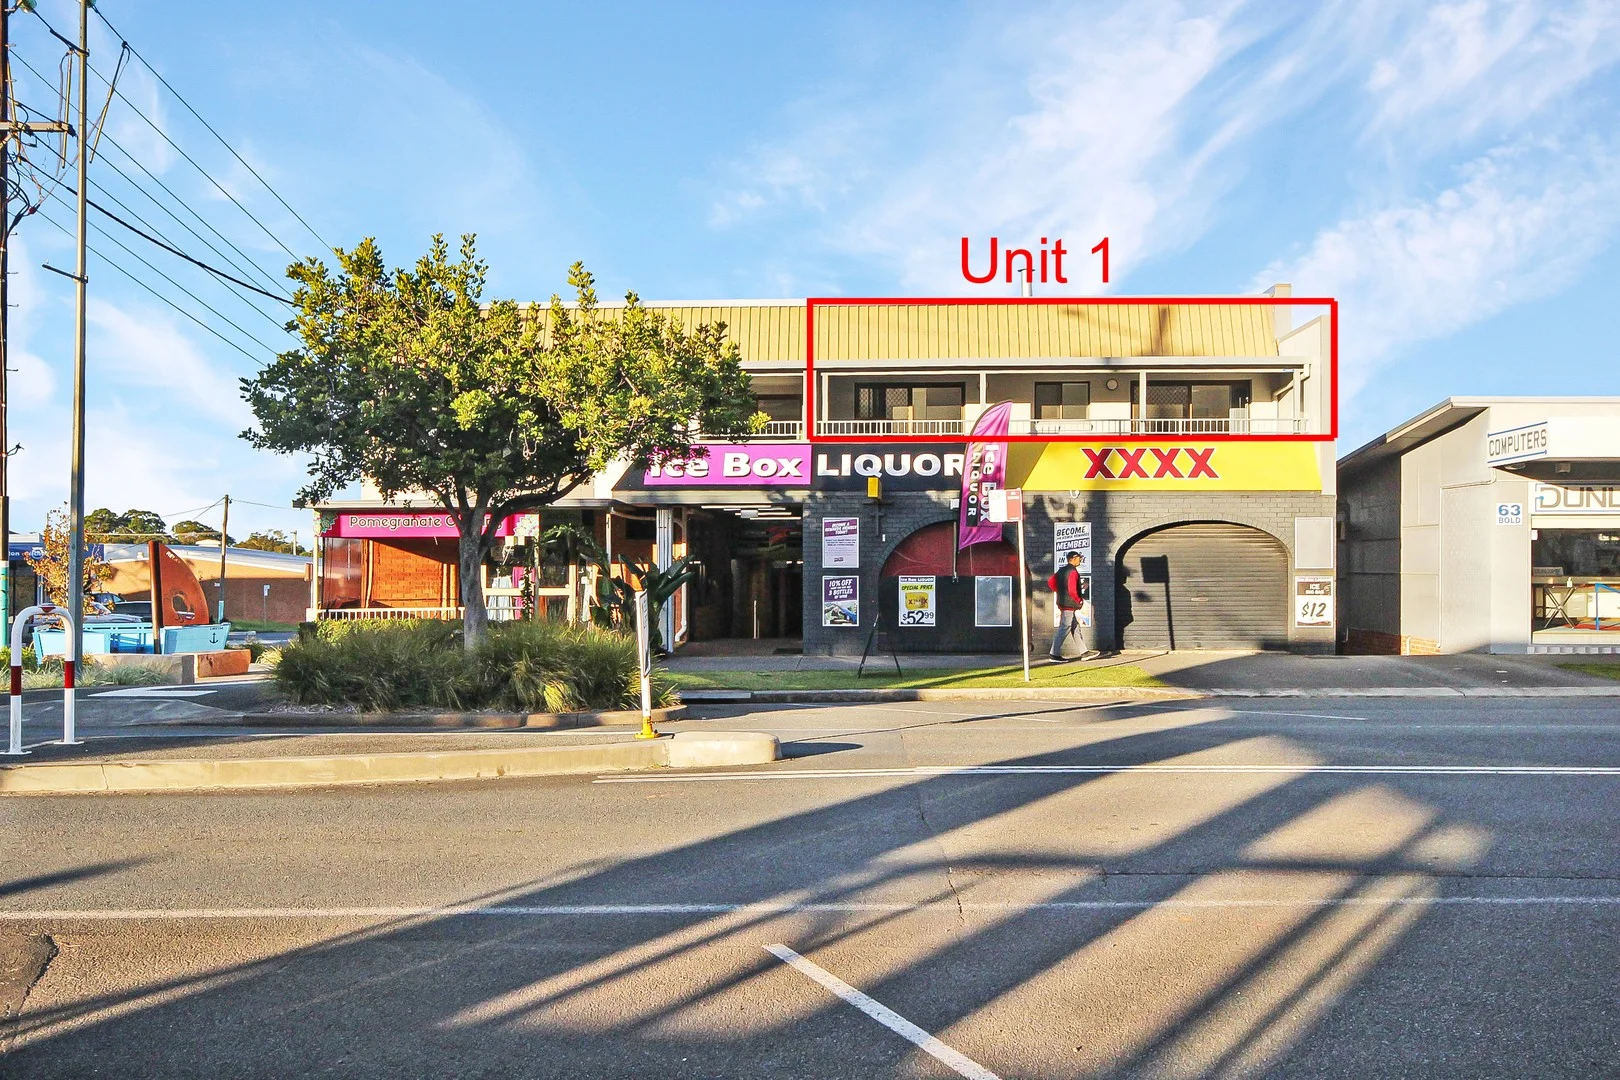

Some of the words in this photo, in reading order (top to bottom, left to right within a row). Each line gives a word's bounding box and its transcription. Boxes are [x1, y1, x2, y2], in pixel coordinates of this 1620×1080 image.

[1488, 429, 1547, 457] COMPUTERS
[648, 451, 709, 478] Ice
[722, 452, 803, 478] Box
[817, 453, 965, 478] LIQUOR
[983, 444, 999, 475] Ice
[1079, 447, 1221, 480] XXXX
[1498, 504, 1521, 516] 63
[350, 515, 442, 530] Pomegranate
[1056, 526, 1086, 536] BECOME
[1056, 539, 1090, 550] MEMBER!
[829, 579, 841, 587] 10%
[833, 588, 854, 596] BOTTLES
[1301, 602, 1327, 618] $12
